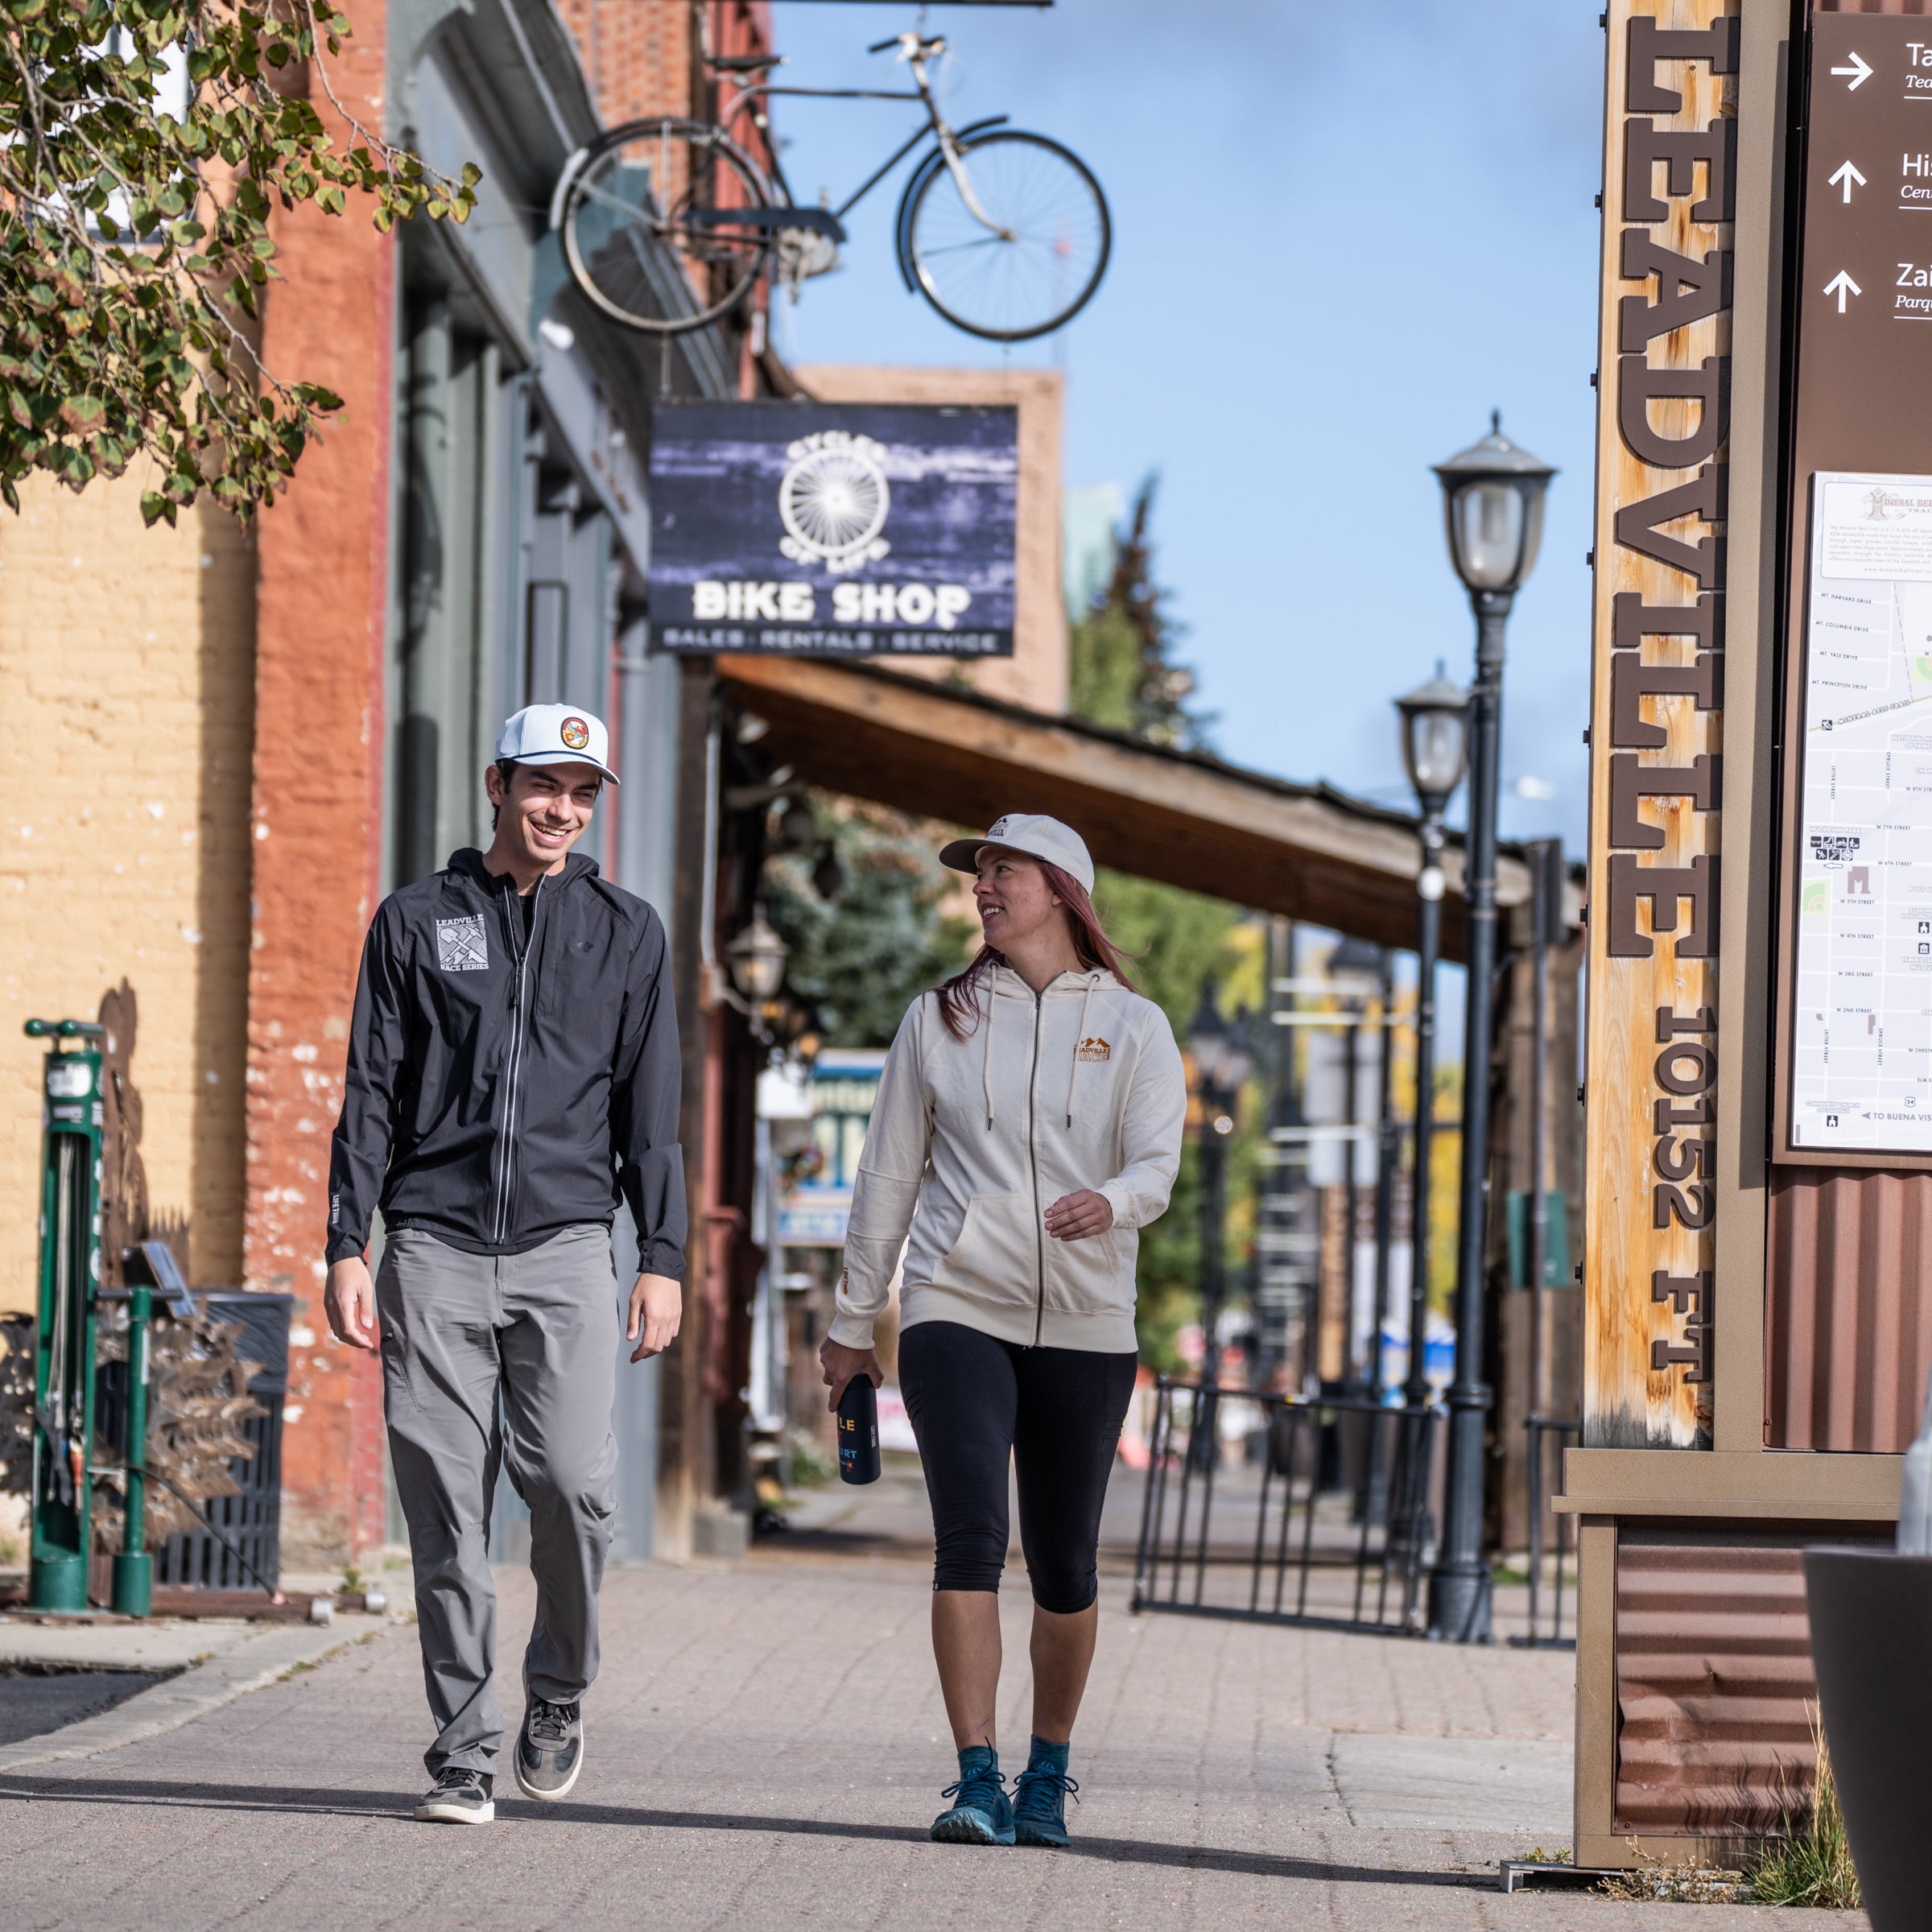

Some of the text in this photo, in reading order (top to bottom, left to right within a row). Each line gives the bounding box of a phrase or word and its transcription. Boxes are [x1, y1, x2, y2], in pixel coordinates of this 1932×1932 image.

[1903, 153, 1932, 177] Hi
[1901, 185, 1932, 199] Cen
[1610, 16, 1740, 956] LEADVILLE
[692, 580, 972, 631] BIKE SHOP
[663, 628, 999, 652] SALES RENTALS SERVICE
[436, 914, 484, 927] LEADVILLE
[440, 964, 461, 972] RACE
[1887, 1113, 1916, 1121] BUENA
[1655, 1006, 1716, 1381] 10152 FT
